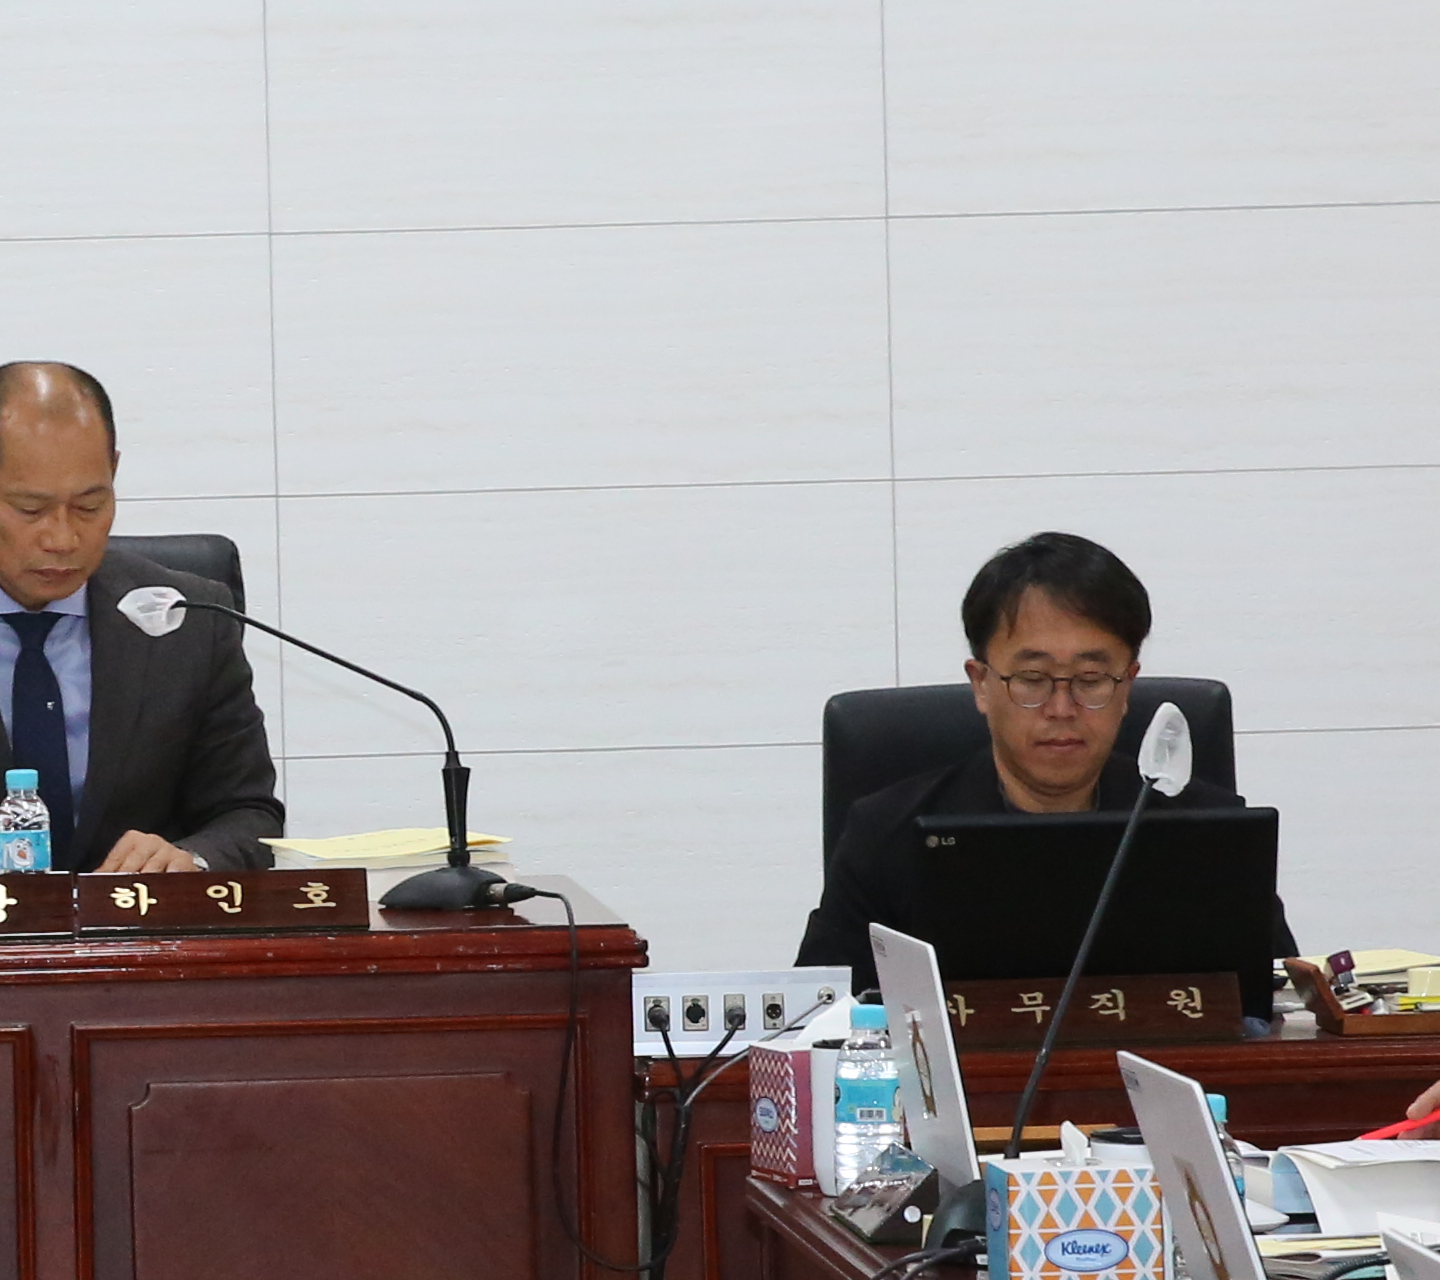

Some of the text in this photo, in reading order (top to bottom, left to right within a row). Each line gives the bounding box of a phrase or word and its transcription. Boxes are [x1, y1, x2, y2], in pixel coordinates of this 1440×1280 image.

[940, 836, 956, 846] LG
[109, 880, 337, 916] 하인호
[1061, 1240, 1113, 1258] Kleenex
